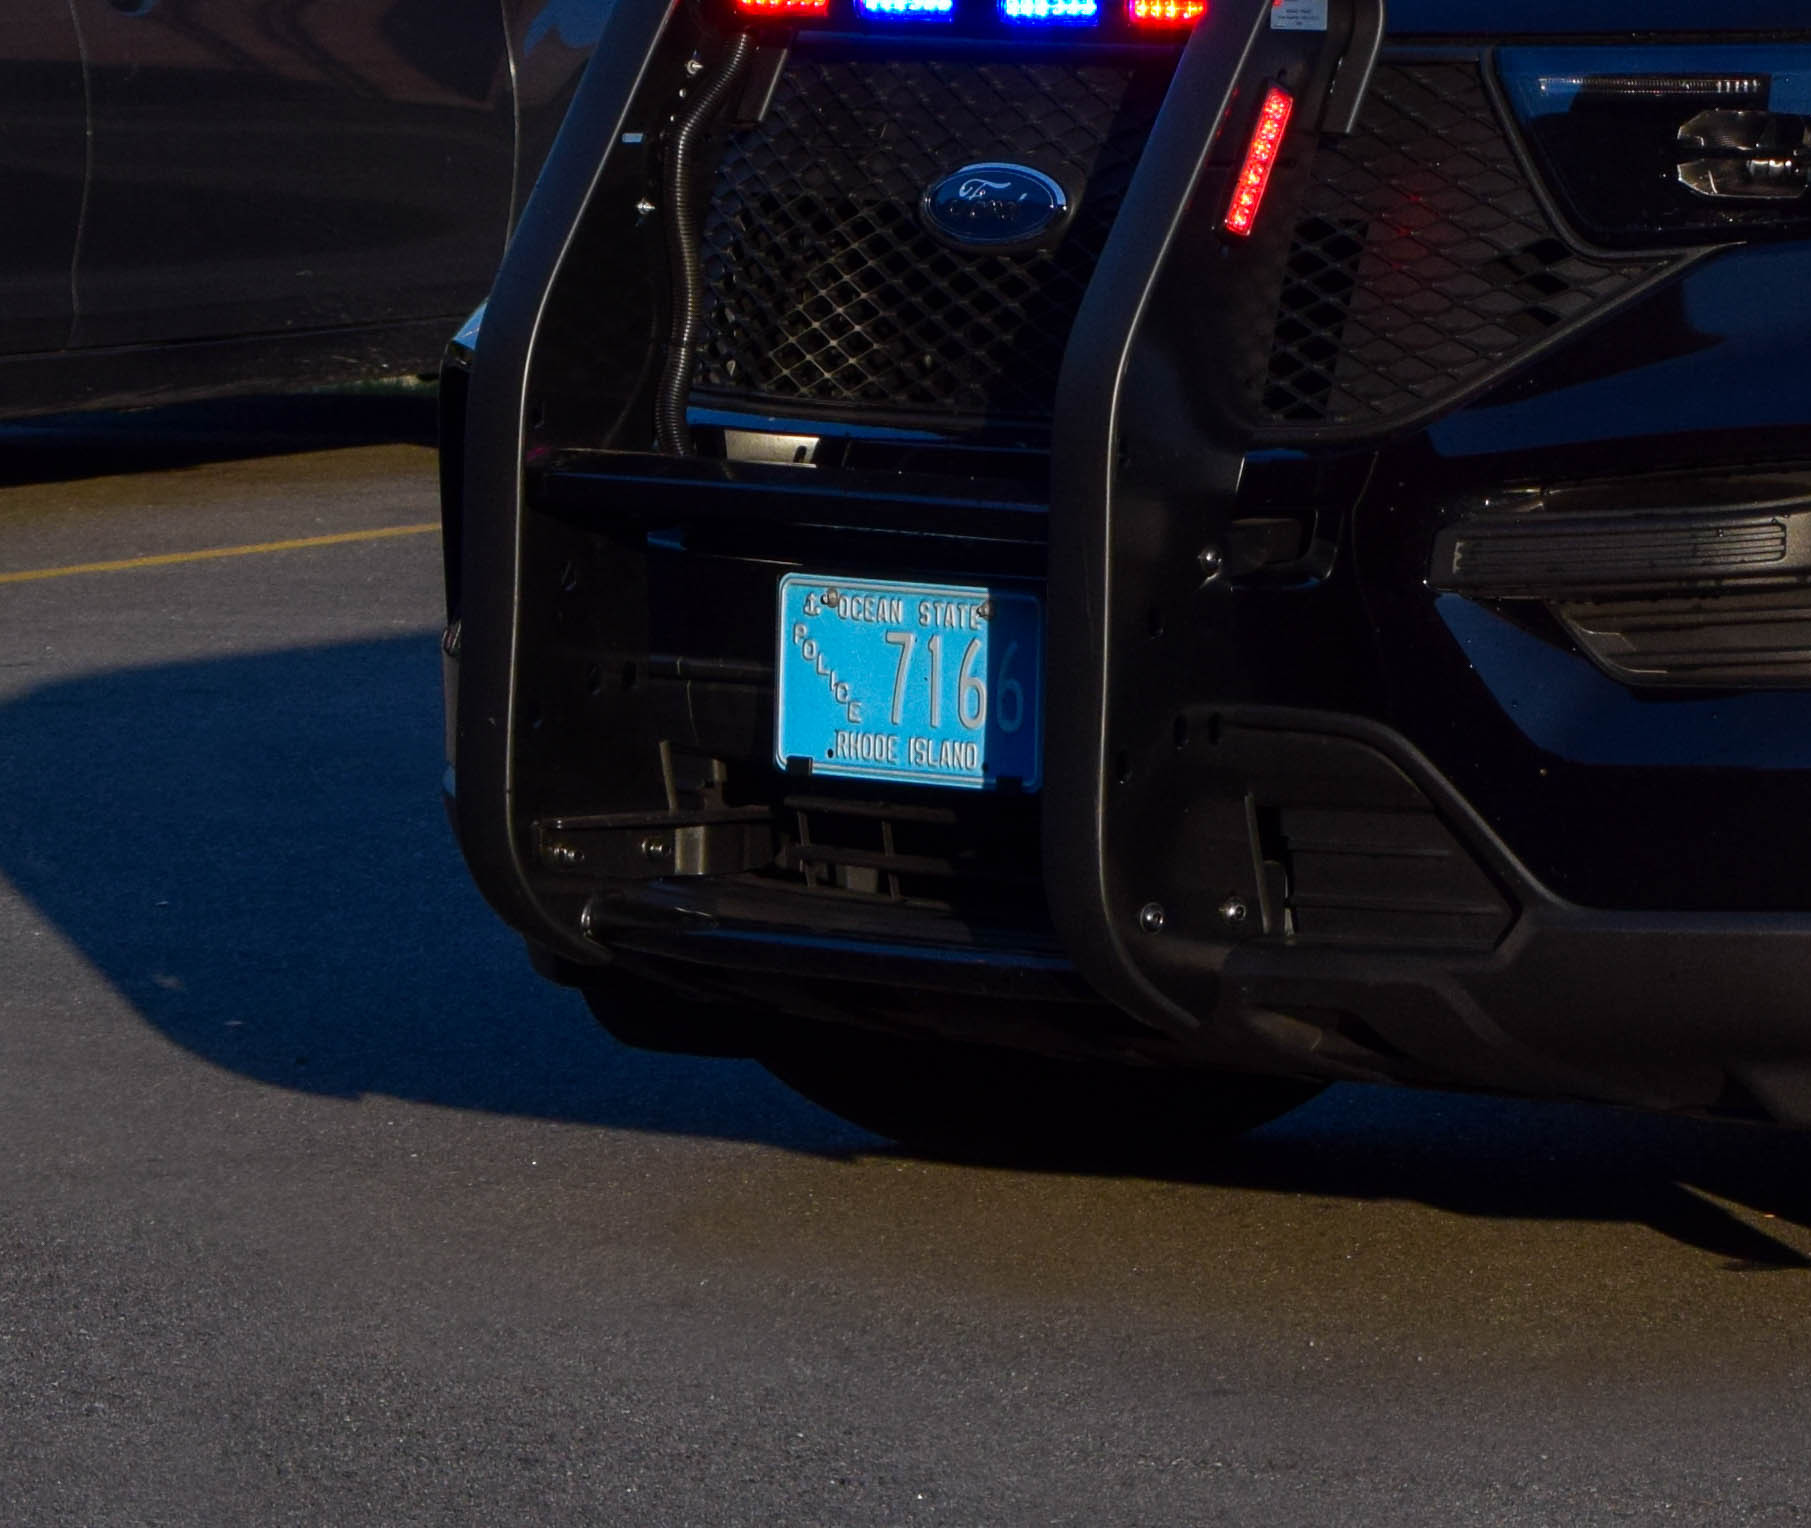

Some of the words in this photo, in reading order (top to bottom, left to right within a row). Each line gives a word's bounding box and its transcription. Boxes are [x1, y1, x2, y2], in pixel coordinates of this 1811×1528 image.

[837, 598, 903, 625] OCEAN
[918, 602, 985, 630] STATE
[793, 623, 862, 724] POLICE
[834, 730, 898, 763] RHODE
[908, 737, 978, 770] ISLAND
